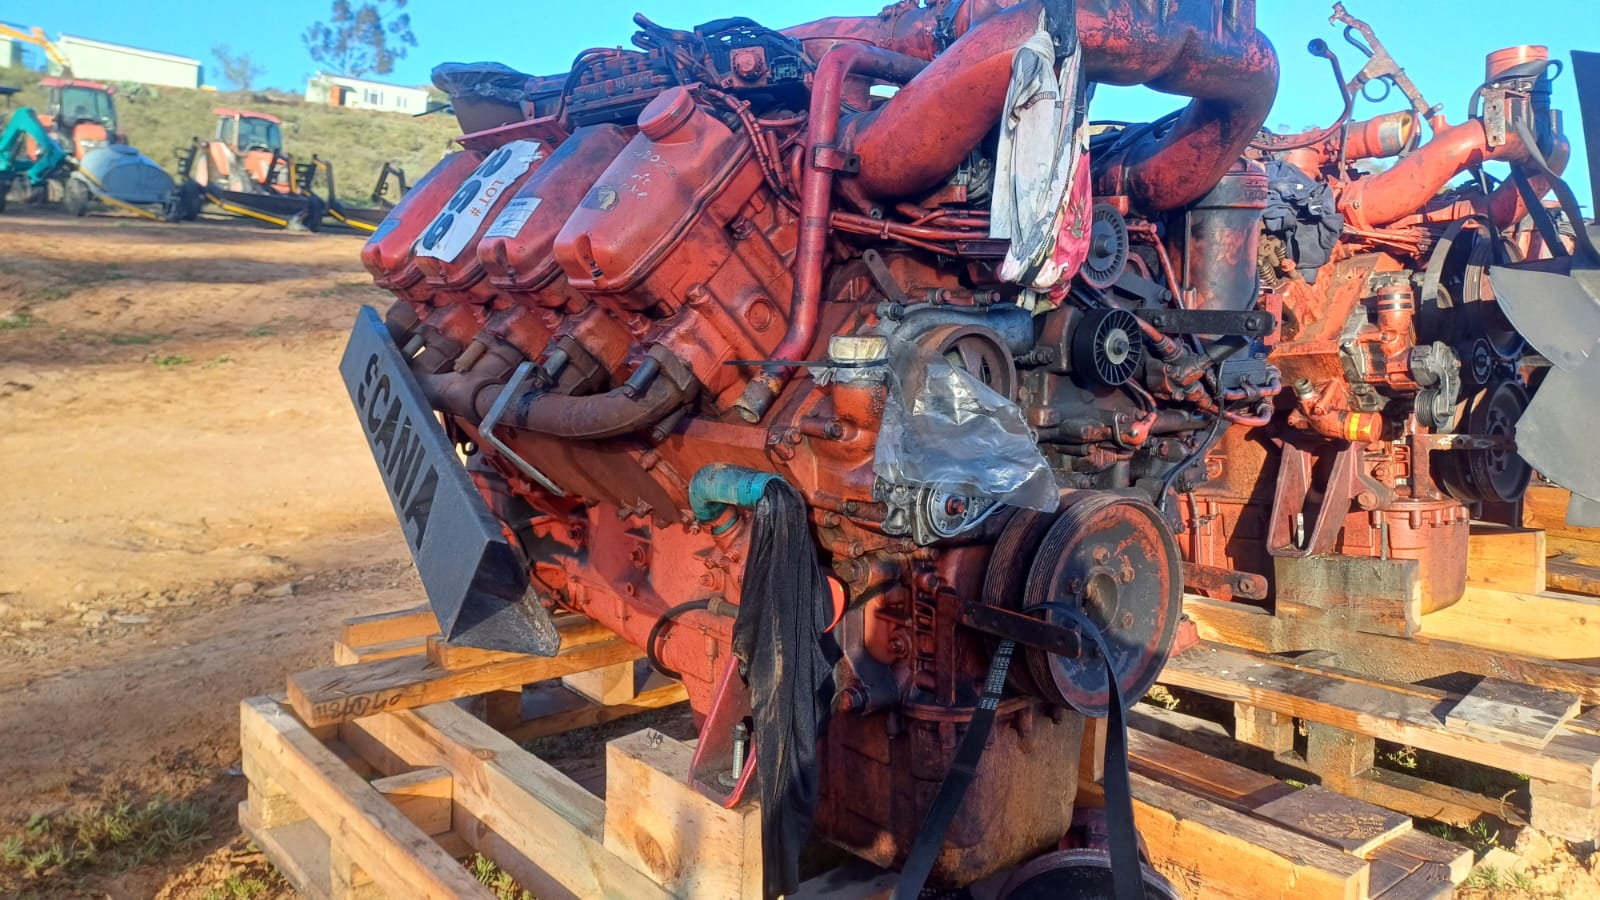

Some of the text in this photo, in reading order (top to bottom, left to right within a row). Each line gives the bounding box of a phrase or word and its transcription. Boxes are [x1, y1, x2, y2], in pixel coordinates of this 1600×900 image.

[423, 148, 513, 251] 269
[479, 180, 505, 207] LOT
[357, 352, 440, 551] SCANIA
